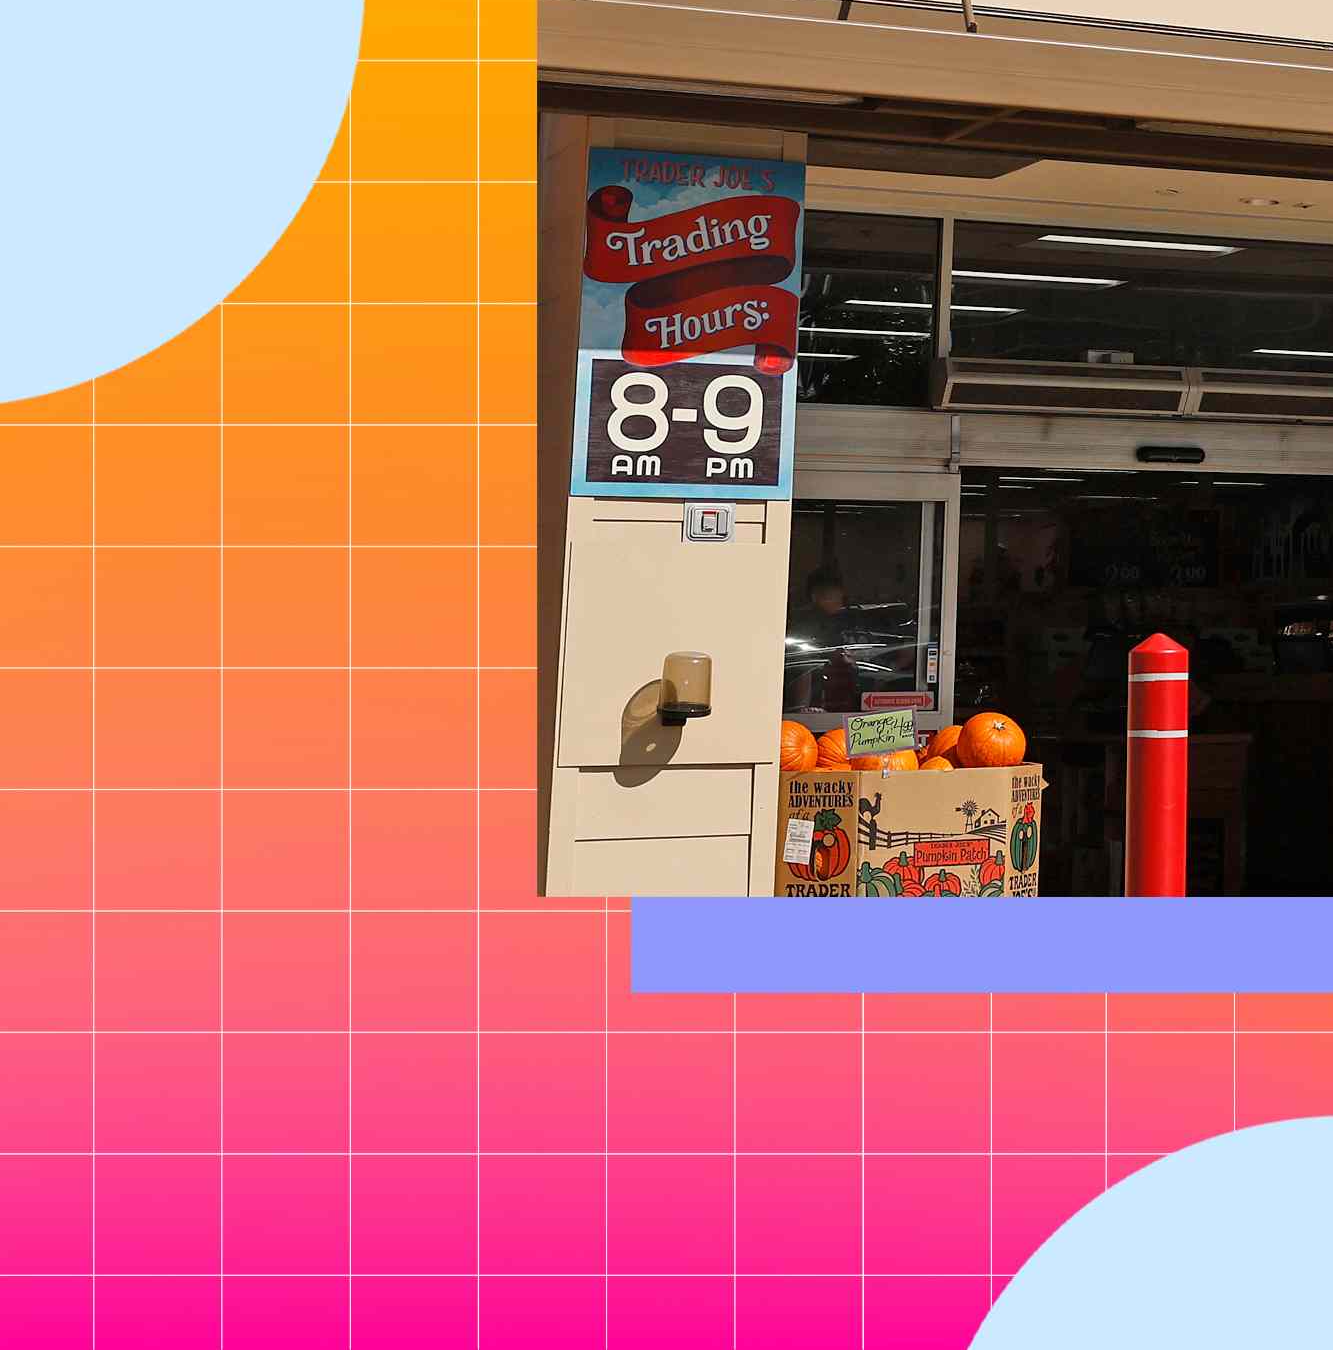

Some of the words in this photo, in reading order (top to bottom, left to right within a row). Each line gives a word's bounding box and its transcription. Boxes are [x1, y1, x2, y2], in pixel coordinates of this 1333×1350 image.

[621, 158, 706, 188] TRADER
[713, 165, 776, 194] JOE'S
[606, 214, 772, 267] Trading
[645, 300, 770, 349] Hours:
[611, 454, 661, 477] AM
[706, 457, 754, 479] PM
[851, 716, 893, 734] Orange
[850, 731, 895, 751] Pumpkin
[789, 780, 809, 794] the
[814, 778, 855, 796] wacky
[788, 794, 854, 808] ADVENTURES
[916, 849, 958, 864] Pumpkin
[960, 846, 987, 861] Patch
[784, 883, 851, 897] TRADER
[1010, 872, 1037, 890] TRADER
